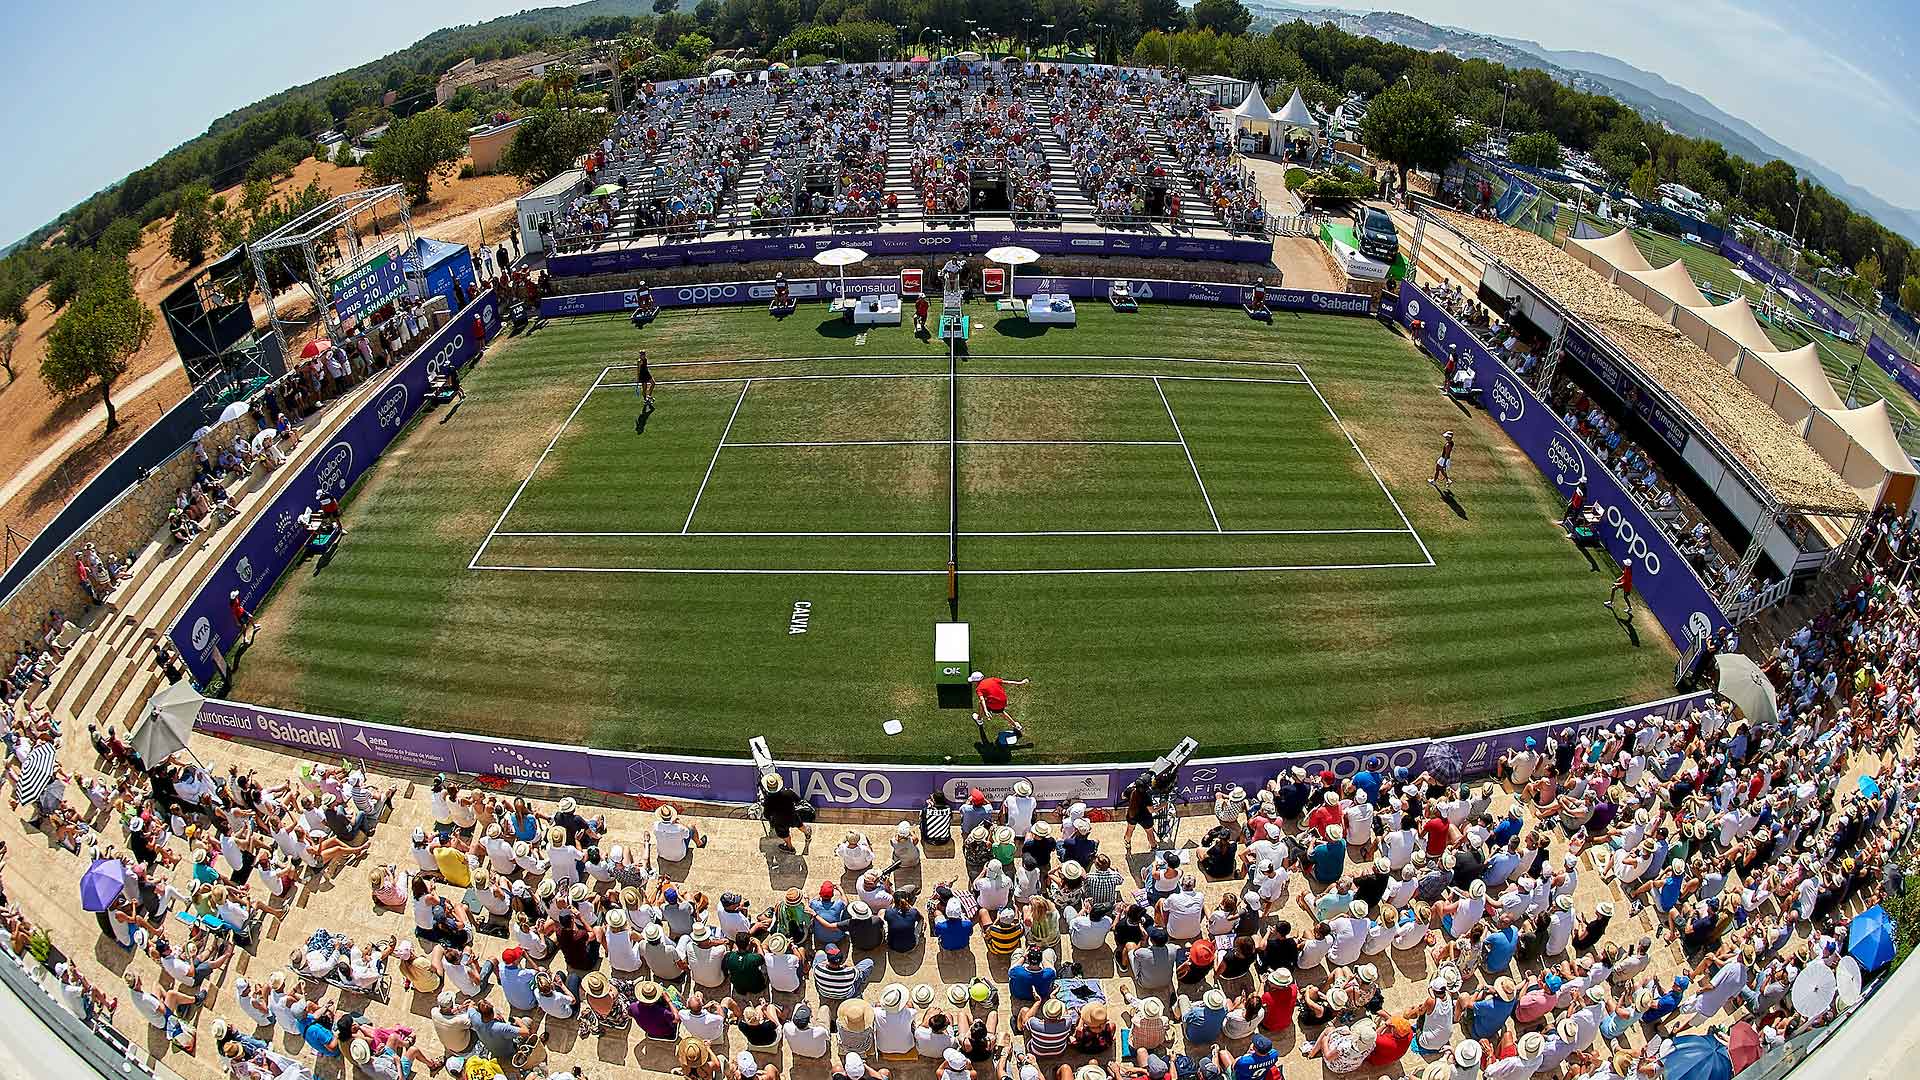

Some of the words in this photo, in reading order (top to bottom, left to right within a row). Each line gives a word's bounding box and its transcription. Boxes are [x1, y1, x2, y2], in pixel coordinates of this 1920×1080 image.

[918, 237, 952, 246] oppo
[342, 264, 373, 288] KERBER
[342, 286, 359, 300] GER
[360, 280, 367, 290] 6
[369, 274, 376, 285] 0
[390, 262, 397, 271] 0
[346, 300, 362, 315] RUS
[363, 293, 371, 305] 2
[372, 287, 379, 299] 0
[393, 275, 400, 284] 0
[366, 283, 408, 315] SHARAPOVA
[624, 294, 638, 305] SA
[678, 286, 737, 304] oppo
[1188, 292, 1220, 301] Mallorca
[1319, 296, 1368, 312] Sabadell
[427, 334, 464, 373] oppo
[377, 390, 403, 421] Mallorca
[1492, 390, 1509, 411] Open
[1494, 379, 1520, 409] Mallorca
[380, 407, 398, 428] Open
[1666, 431, 1682, 448] group
[318, 449, 347, 484] Mallorca
[1547, 447, 1569, 474] Open
[1551, 437, 1580, 473] Mallorca
[321, 469, 342, 493] Open
[1607, 505, 1661, 575] oppo
[789, 601, 812, 635] CALVIA
[193, 623, 210, 644] WTA
[942, 667, 961, 675] OK
[268, 719, 342, 749] Sabadell
[369, 736, 388, 747] aena
[493, 762, 550, 780] Mallorca
[1302, 748, 1417, 779] oppo
[663, 770, 710, 783] XARXA
